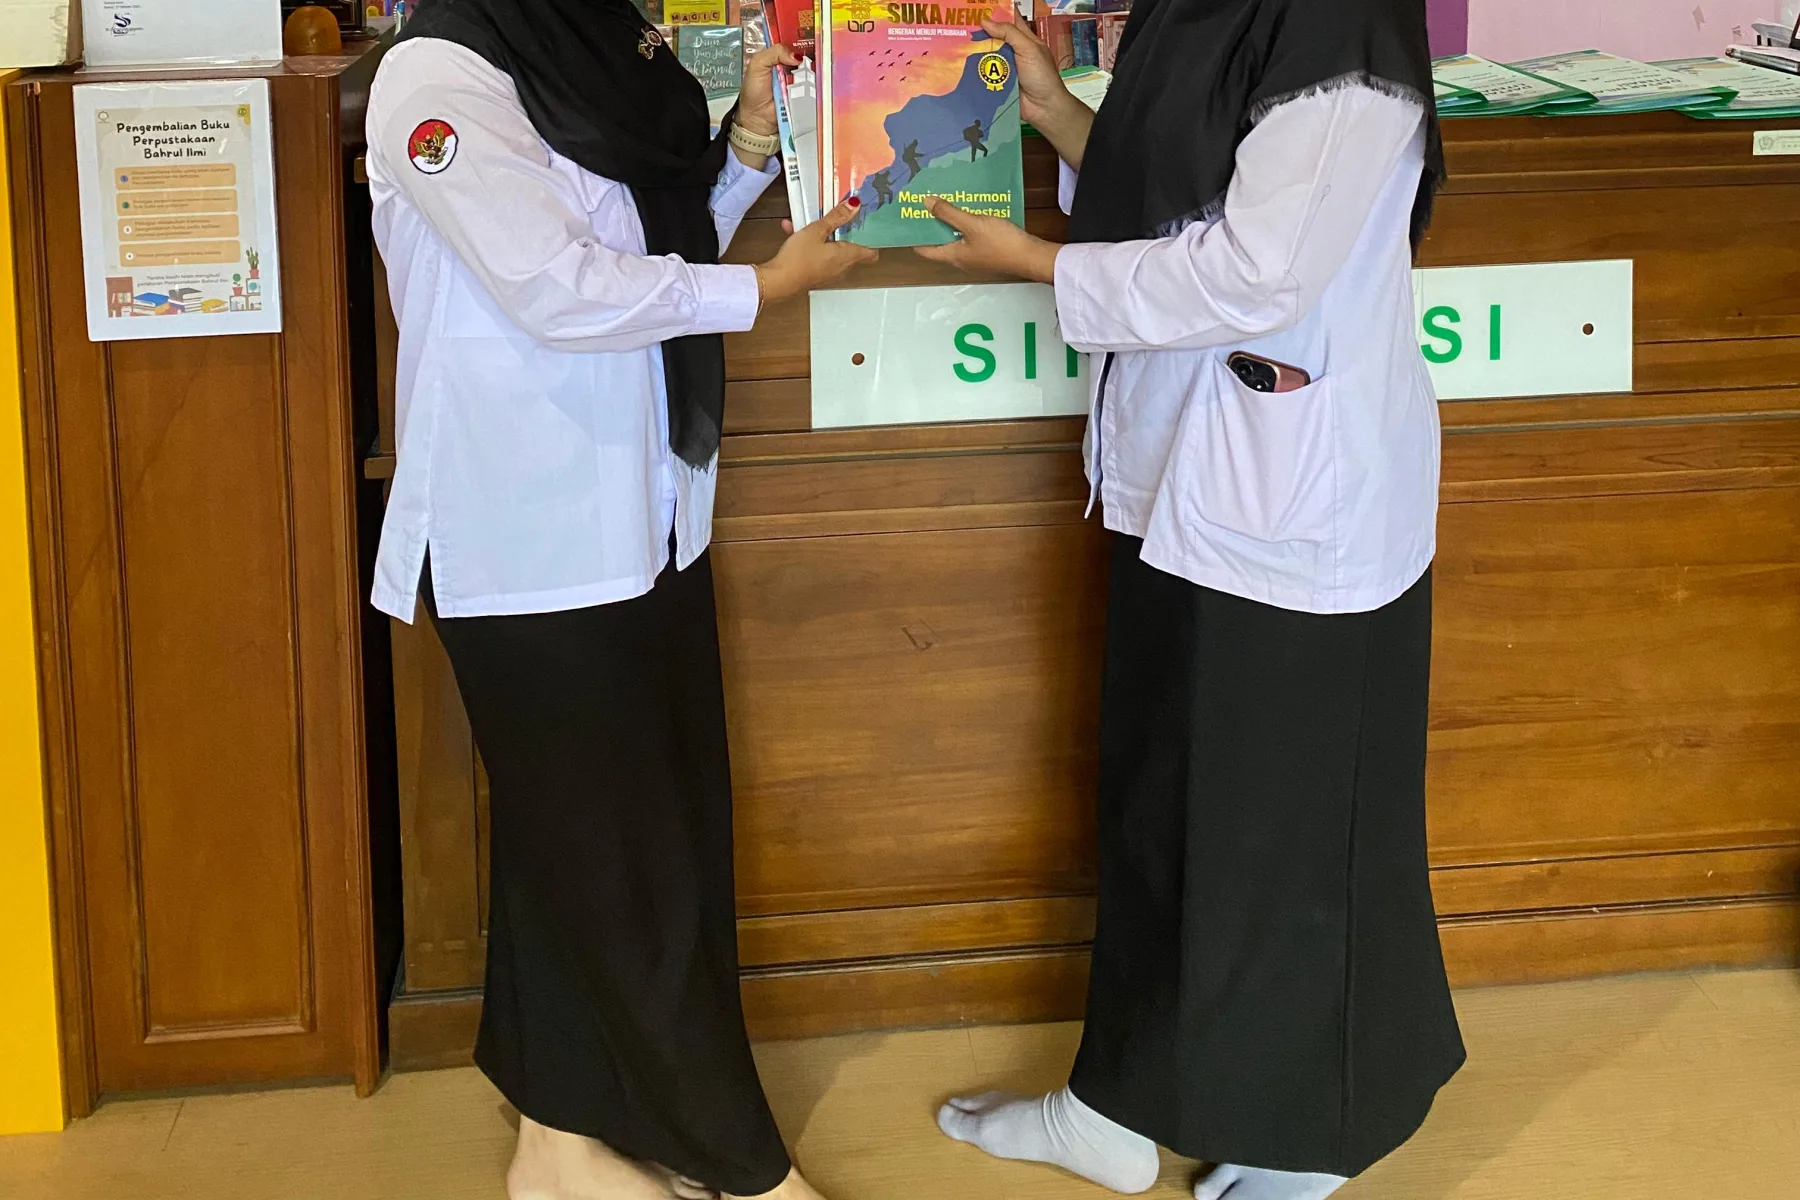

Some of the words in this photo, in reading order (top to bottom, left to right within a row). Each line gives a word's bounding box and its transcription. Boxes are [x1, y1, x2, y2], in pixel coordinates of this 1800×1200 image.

[672, 12, 719, 22] MAGIC
[887, 2, 943, 26] SUKA
[887, 27, 916, 36] BERGERAK
[936, 28, 967, 37] PERUBAHAN
[989, 62, 1001, 77] A
[116, 121, 197, 135] Pengembalian
[201, 119, 230, 130] Buku
[133, 135, 216, 148] Perpustakaan
[144, 148, 183, 159] Bahrul
[955, 189, 1011, 203] Harmoni
